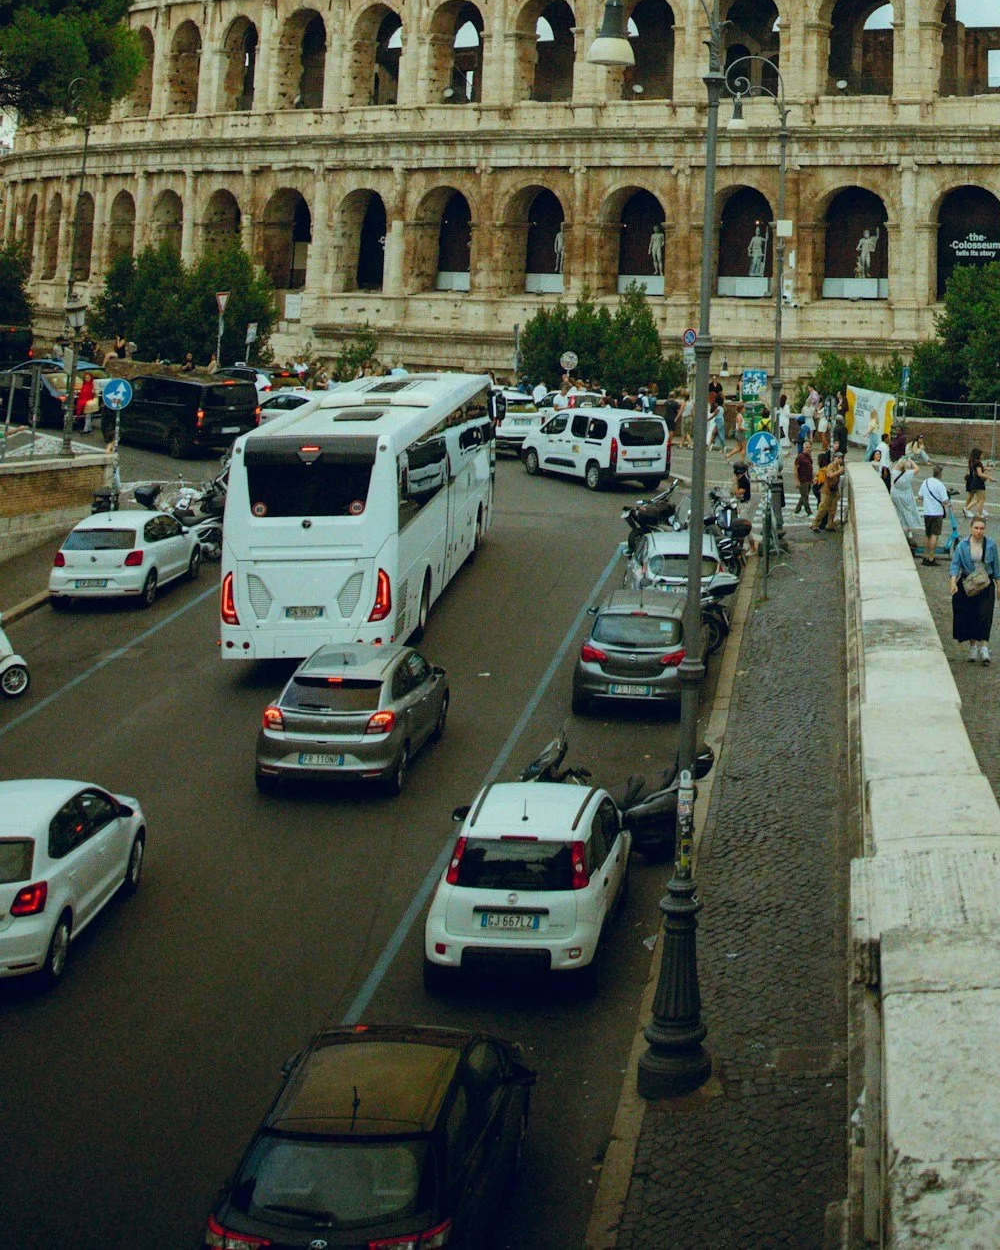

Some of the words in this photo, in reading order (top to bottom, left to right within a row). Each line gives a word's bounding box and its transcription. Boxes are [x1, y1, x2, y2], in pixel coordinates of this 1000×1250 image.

[968, 232, 985, 241] the
[952, 240, 1000, 249] Colosseum
[502, 915, 533, 928] 667LZ
